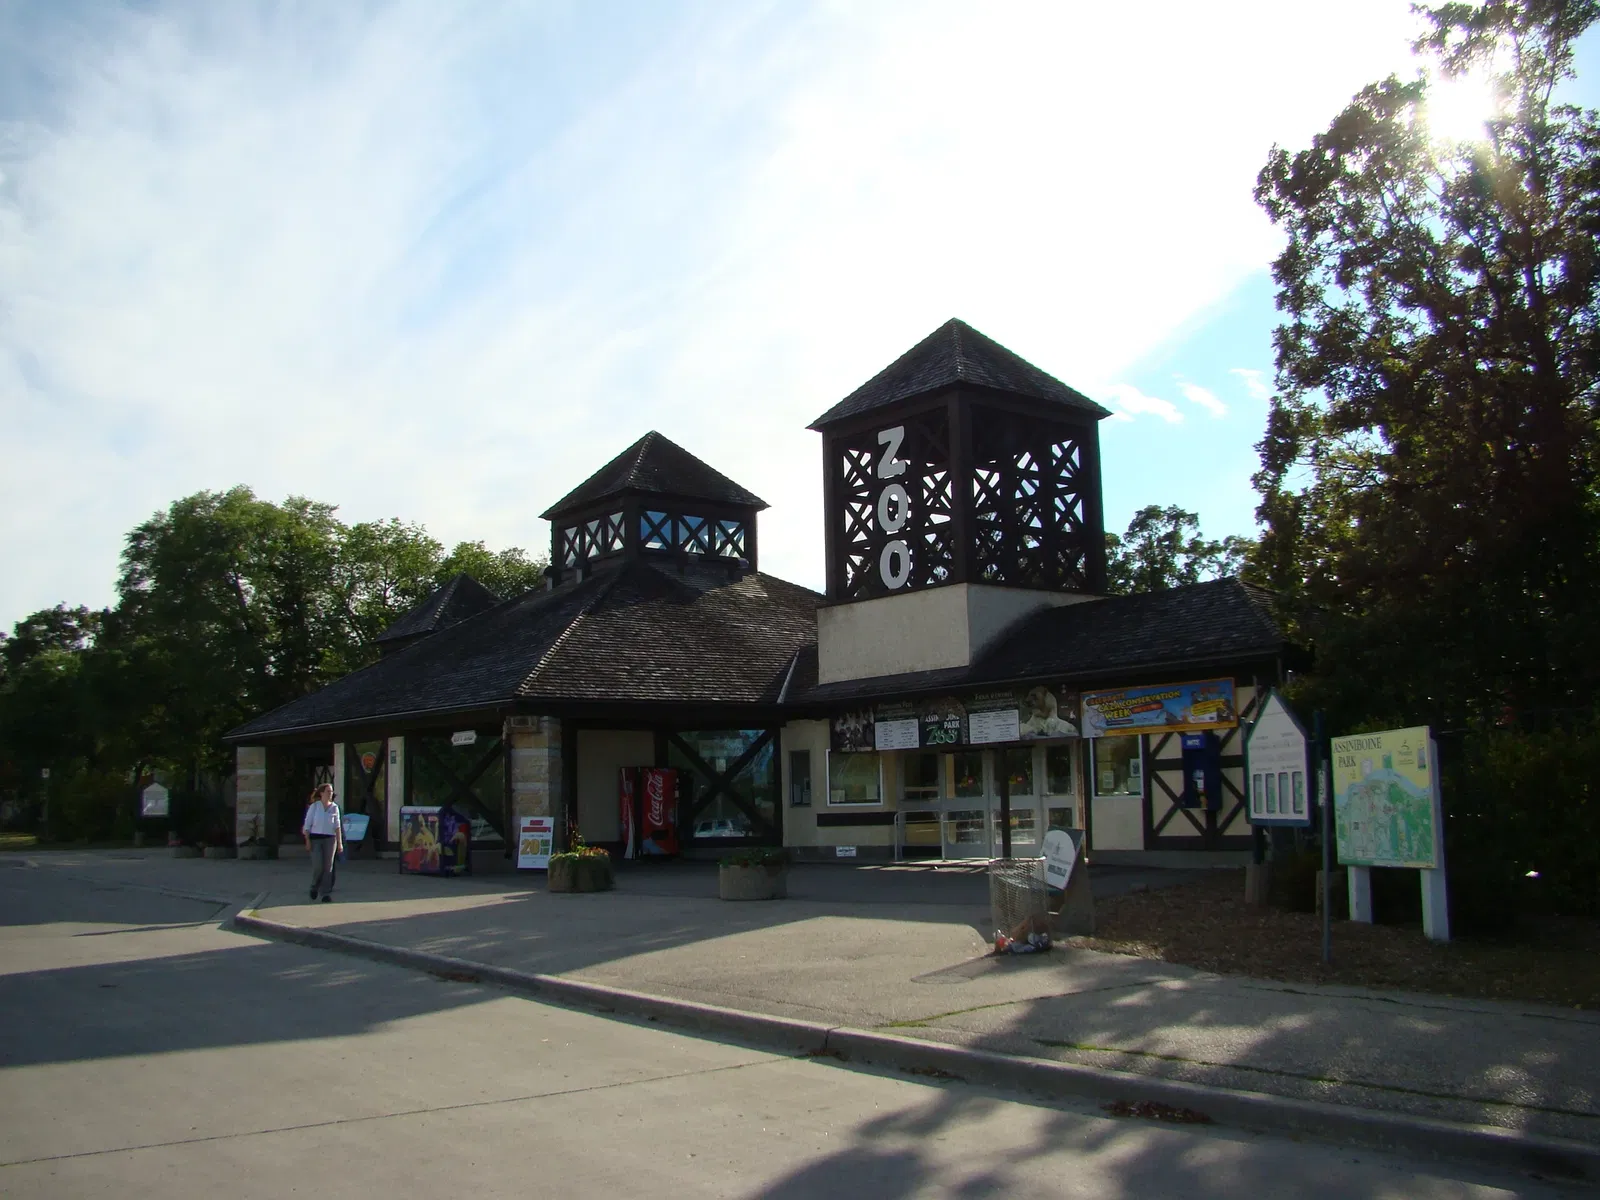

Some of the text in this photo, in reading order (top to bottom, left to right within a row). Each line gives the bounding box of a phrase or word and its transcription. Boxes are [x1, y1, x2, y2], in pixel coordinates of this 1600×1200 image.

[877, 425, 911, 590] ZOO
[1121, 691, 1181, 707] CONSERVATION
[1104, 708, 1132, 720] WEEK
[944, 720, 960, 729] PARK
[1334, 737, 1382, 754] ASSINIBOINE
[1338, 755, 1356, 768] PARK
